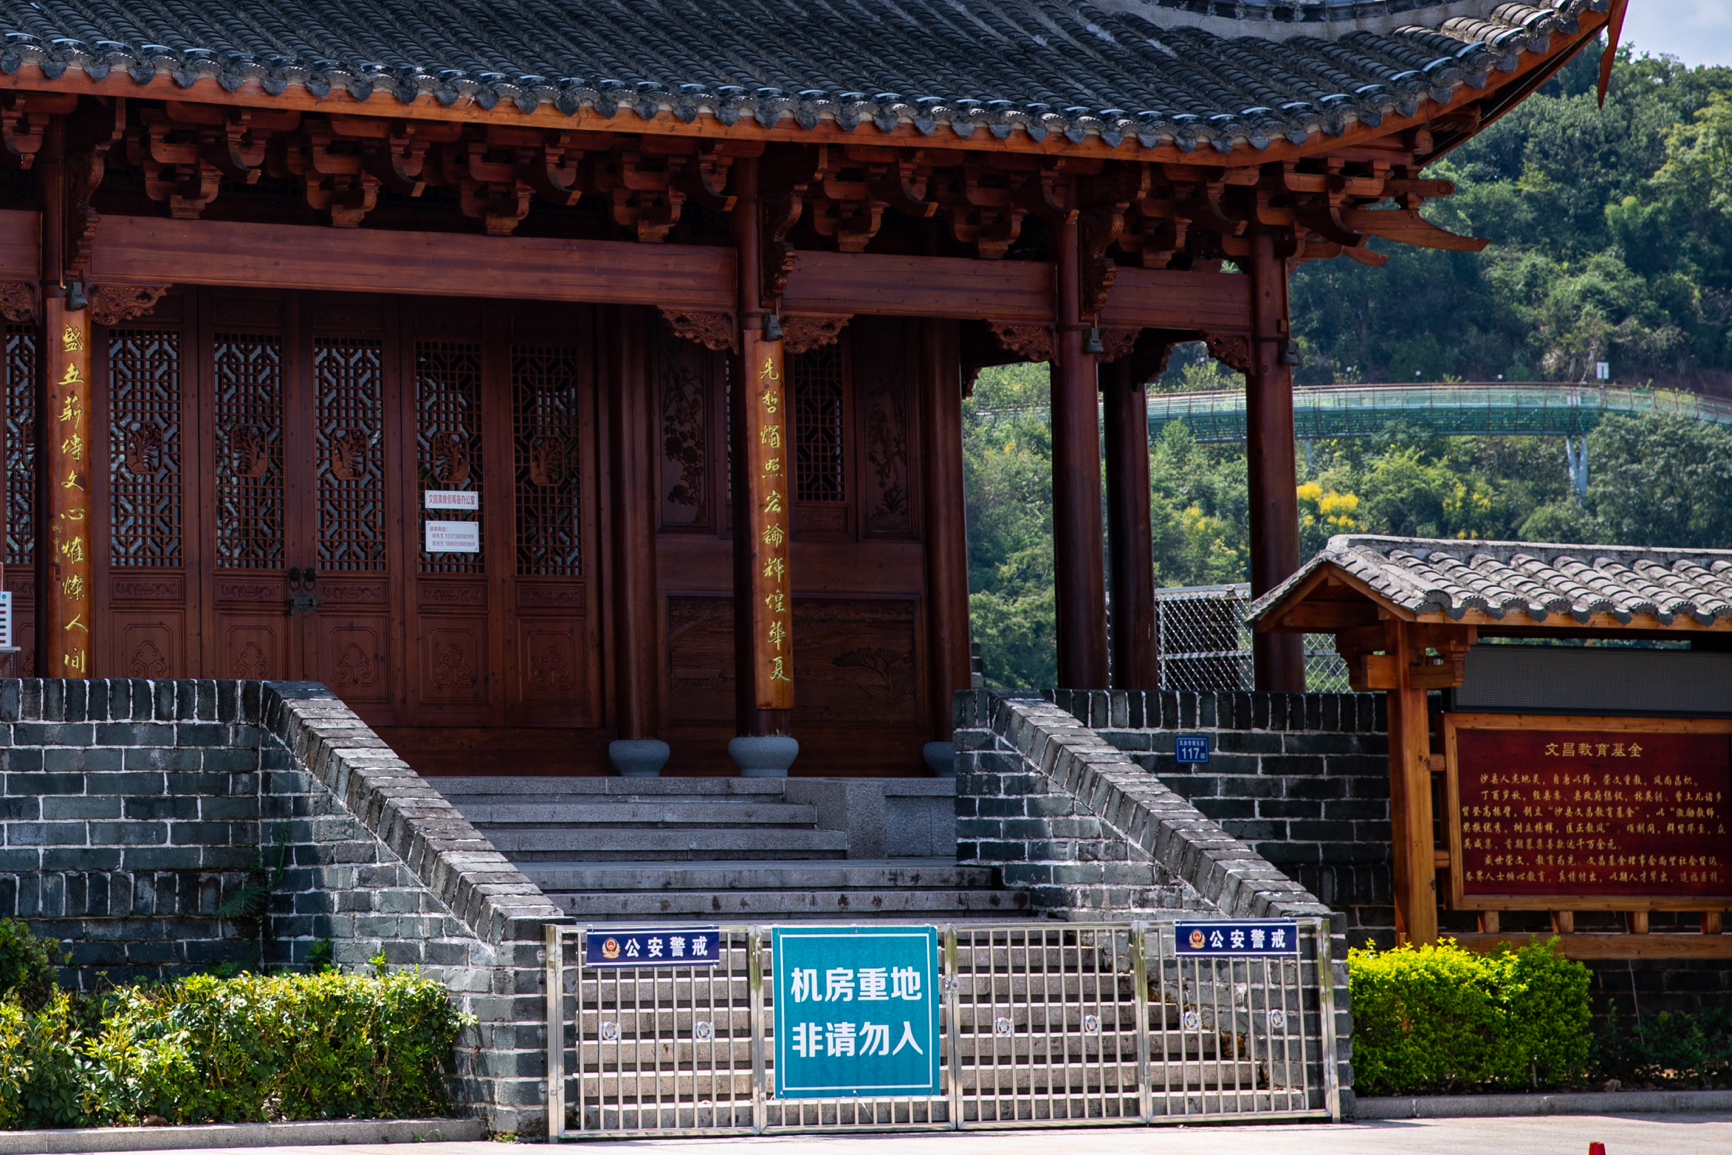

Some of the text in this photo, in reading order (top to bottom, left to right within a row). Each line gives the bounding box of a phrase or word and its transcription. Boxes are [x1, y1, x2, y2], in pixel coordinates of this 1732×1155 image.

[1544, 742, 1644, 757] 文昌教育基金
[624, 935, 708, 958] 公安警戒
[1209, 929, 1286, 949] 公安警戒
[791, 966, 922, 1003] 机房重地
[792, 1021, 923, 1058] 非请勿入
